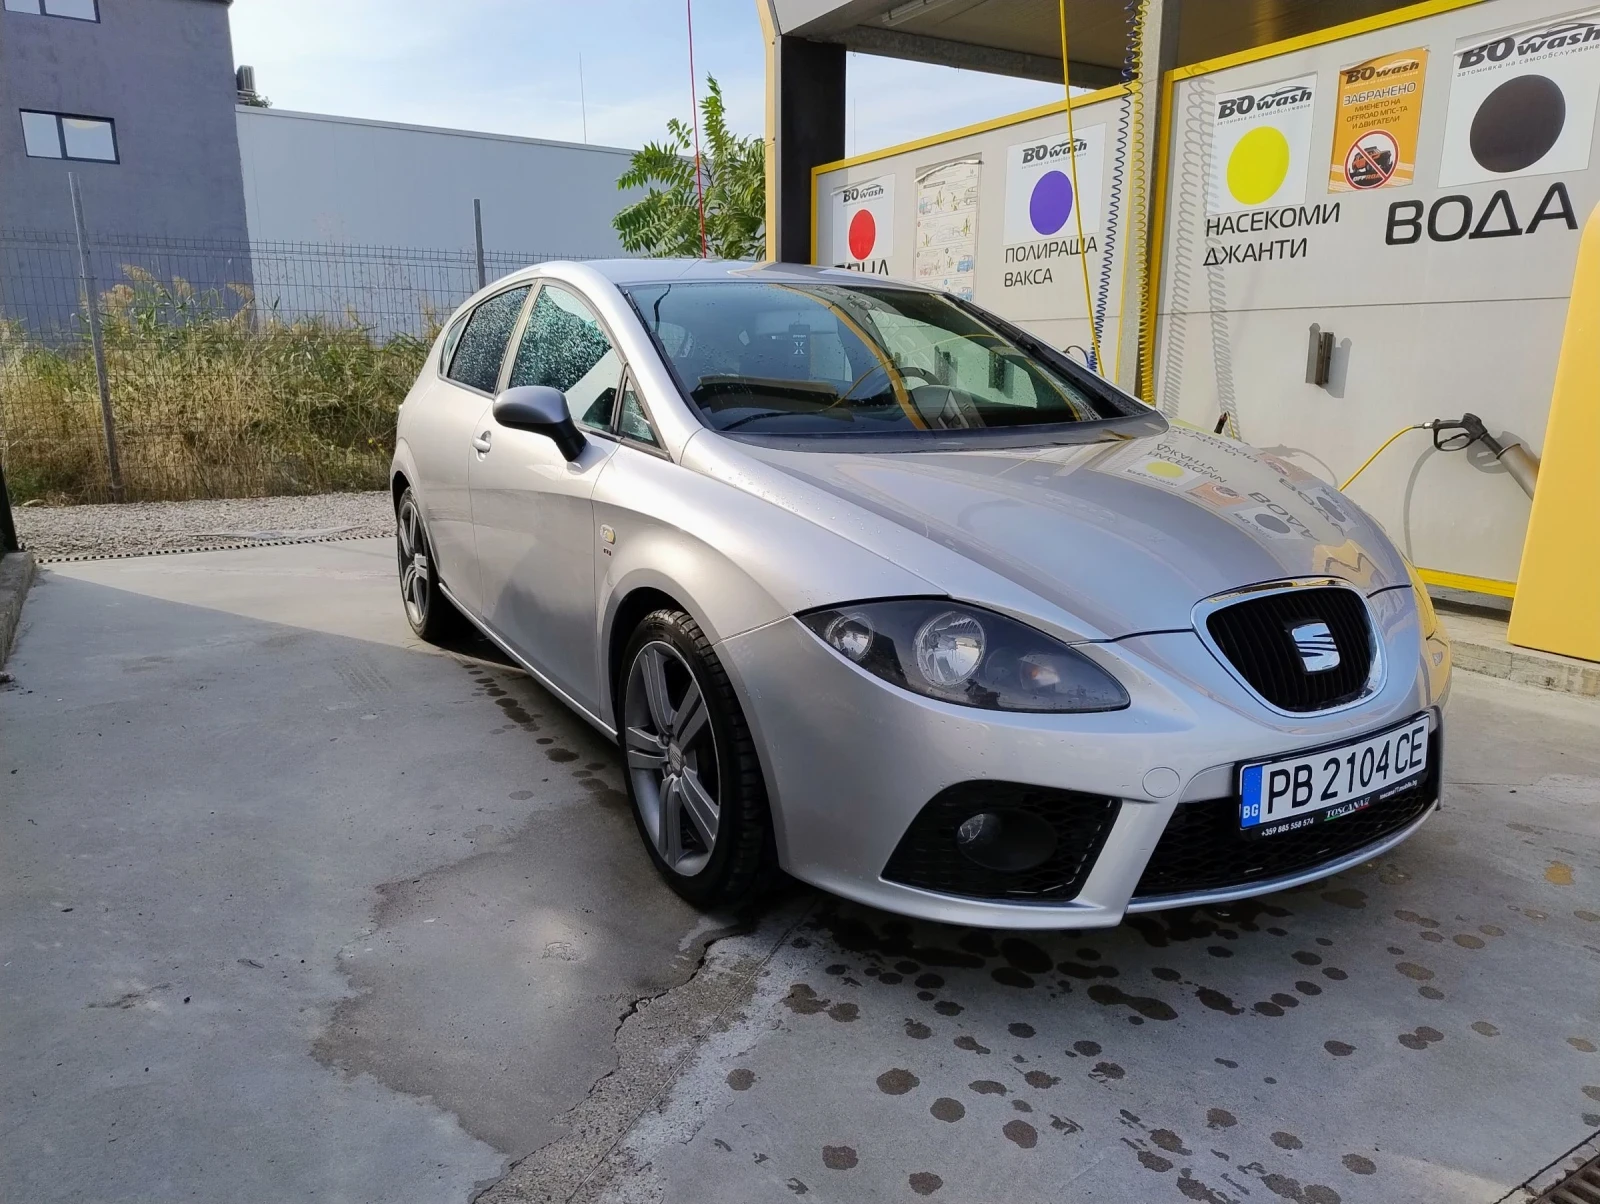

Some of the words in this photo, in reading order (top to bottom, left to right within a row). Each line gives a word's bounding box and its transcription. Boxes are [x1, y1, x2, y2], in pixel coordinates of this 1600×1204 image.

[1218, 89, 1312, 119] BOwash
[1343, 82, 1416, 106] ЗАБРАНЕНО
[1354, 100, 1389, 112] МИЕНЕТО
[1391, 98, 1401, 106] НА
[1346, 110, 1379, 122] OFFROAD
[1380, 106, 1408, 116] МПС-ТА
[1358, 115, 1400, 129] ДВИГАТЕЛИ
[1206, 202, 1340, 237] НАСЕКОМИ
[1385, 182, 1578, 245] ВОДА
[1203, 238, 1307, 266] ДЖАНТИ
[1004, 268, 1053, 287] ВАКСА
[1267, 763, 1313, 814] PB
[1320, 740, 1390, 801] 2104
[1395, 726, 1424, 774] CE
[1243, 804, 1259, 819] BG
